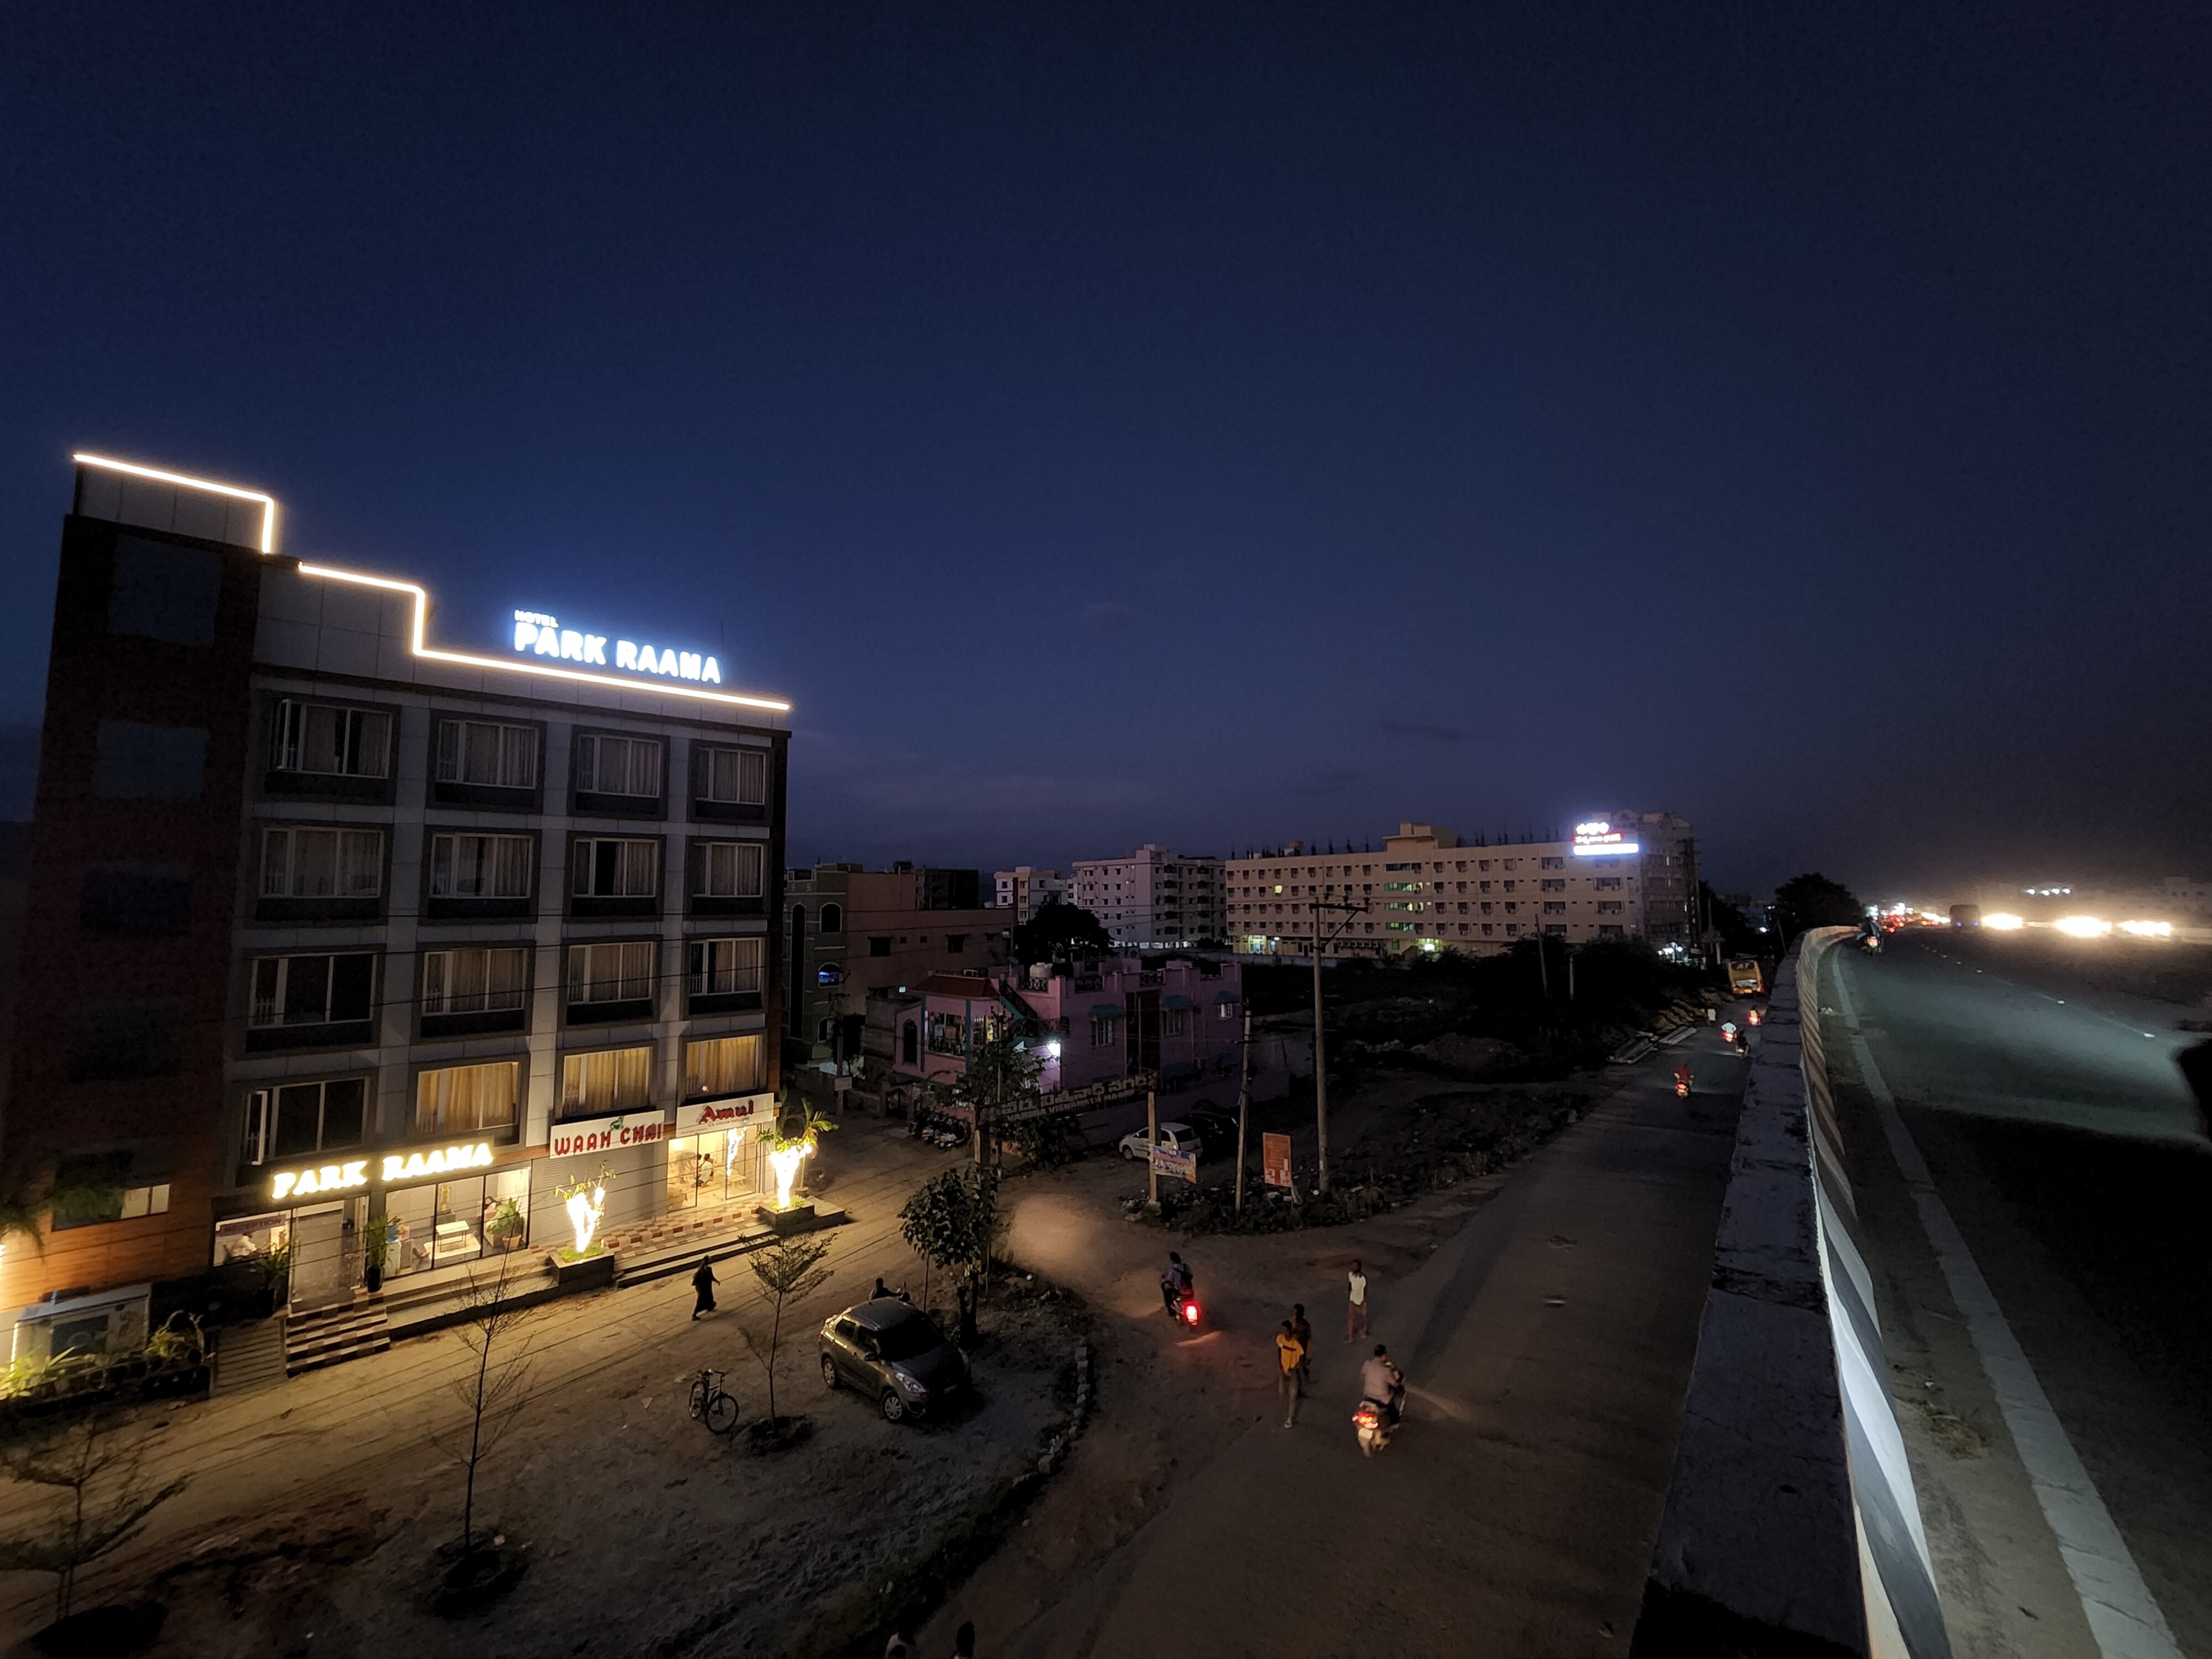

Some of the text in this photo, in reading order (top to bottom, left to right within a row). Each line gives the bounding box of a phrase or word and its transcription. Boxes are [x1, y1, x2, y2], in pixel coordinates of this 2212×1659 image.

[515, 610, 559, 628] HOTEL
[514, 622, 721, 684] PARK RAAMA
[698, 1099, 754, 1125] Amul
[554, 1123, 662, 1156] WAAH CHAI
[272, 1142, 494, 1199] PARK RAAMA
[223, 1218, 281, 1233] RECEPTION
